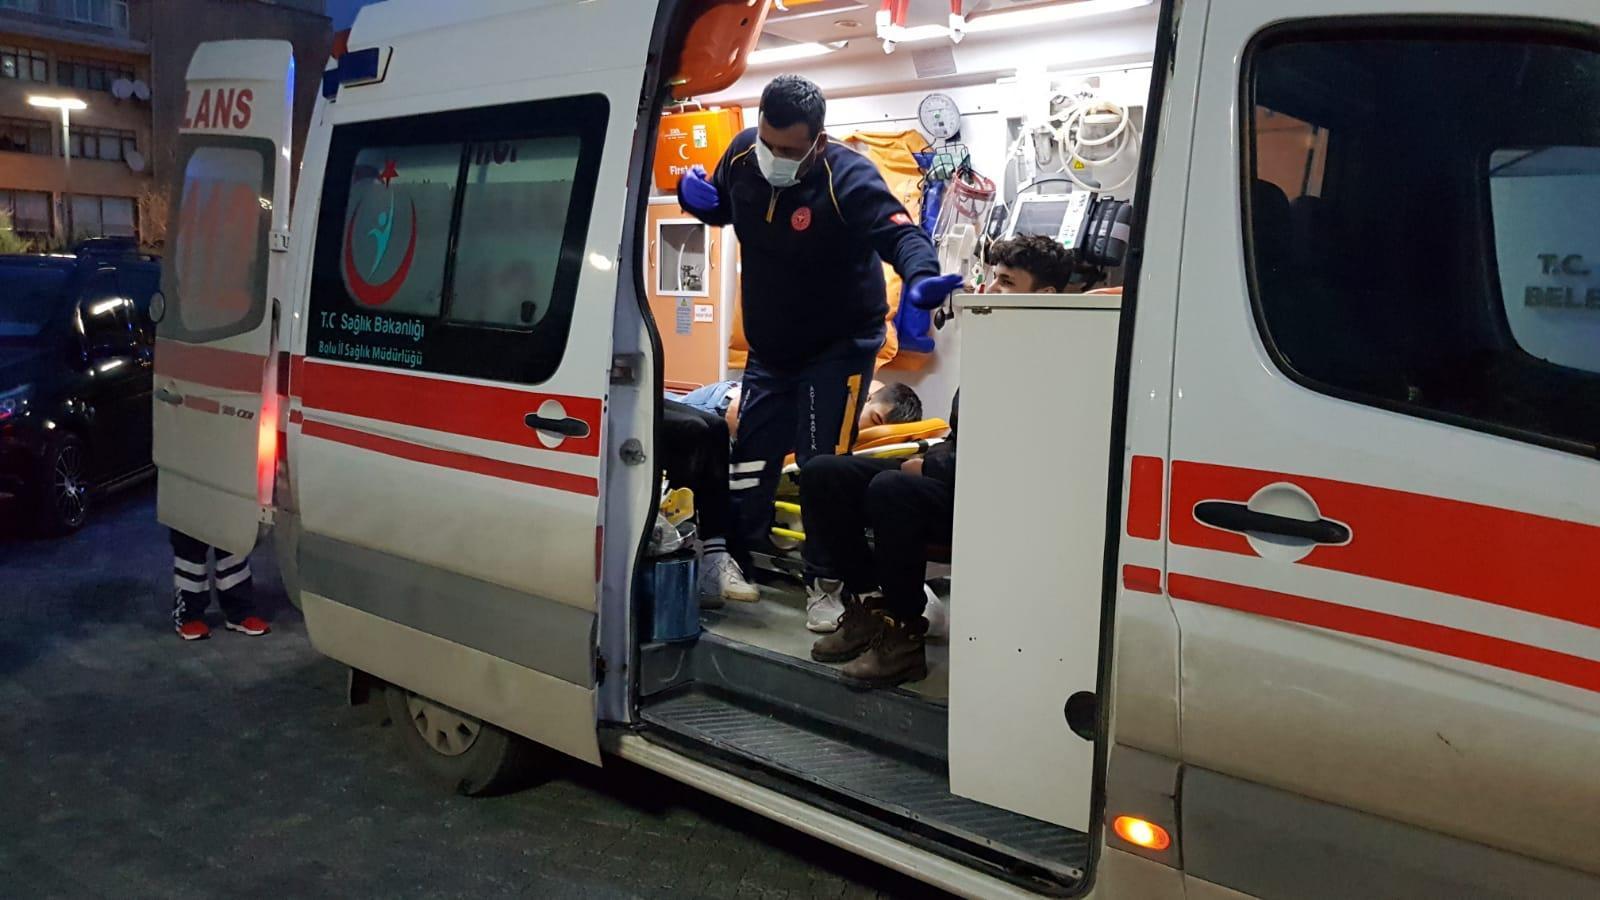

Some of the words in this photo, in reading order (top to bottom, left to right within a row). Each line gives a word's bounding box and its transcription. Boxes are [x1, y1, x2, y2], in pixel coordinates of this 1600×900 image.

[341, 312, 372, 335] Sağlık
[374, 316, 425, 341] Bakanlığı
[318, 340, 336, 354] Bolu
[345, 342, 370, 360] Sağlık
[372, 346, 423, 368] Müdürlüğü
